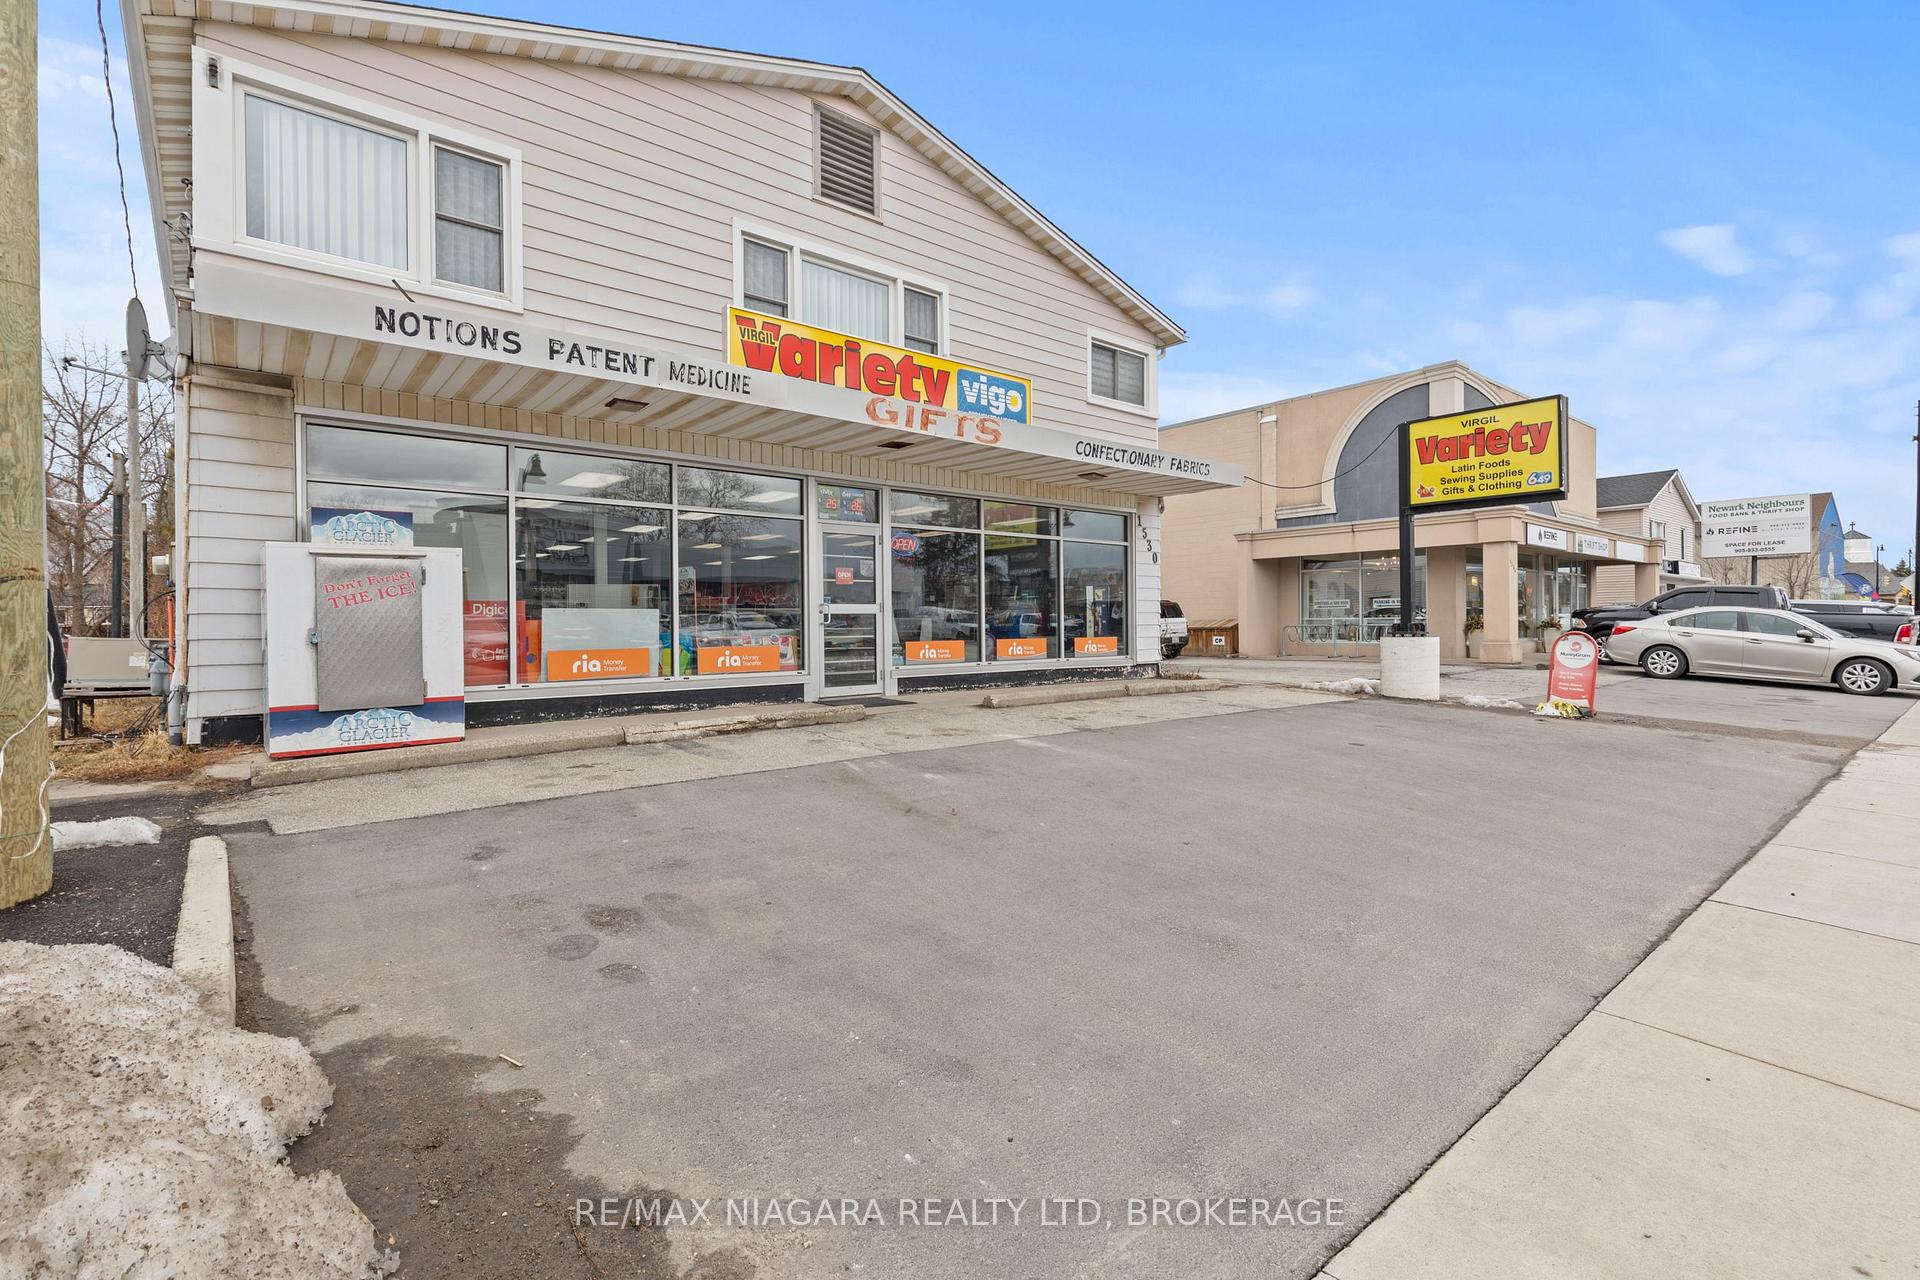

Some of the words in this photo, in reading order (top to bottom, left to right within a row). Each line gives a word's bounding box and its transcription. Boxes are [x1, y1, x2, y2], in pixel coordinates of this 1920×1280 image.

[739, 325, 776, 346] VIRGIL
[375, 306, 522, 354] NOTIONS
[549, 338, 655, 377] PATENT
[669, 360, 751, 395] MEDICINE
[735, 315, 950, 407] Variety
[961, 374, 1023, 416] vigo
[865, 397, 1003, 445] GIFTS
[1461, 415, 1500, 428] VIRGIL
[1415, 421, 1552, 465] Variety
[1075, 440, 1165, 469] CONFECTONARY
[1170, 457, 1210, 476] FABRICS
[1451, 464, 1475, 473] Latin
[1478, 458, 1511, 470] Foods
[1440, 473, 1476, 485] Sewing
[1478, 468, 1524, 483] Supplies
[1442, 484, 1465, 496] Gifts
[1467, 483, 1475, 493] &
[1478, 480, 1522, 492] Clothing
[1708, 503, 1745, 513] Newark
[1747, 499, 1805, 511] Neighbours
[332, 517, 396, 534] ARCTIC
[1718, 525, 1758, 535] REFINE
[333, 530, 395, 544] GLACIER
[890, 538, 917, 551] OPEN
[1137, 515, 1158, 564] 1530
[323, 577, 364, 594] Don't
[366, 569, 412, 587] Forget
[328, 590, 373, 609] THE
[378, 580, 418, 601] ICE!
[920, 645, 937, 659] ria
[1008, 642, 1023, 656] ria
[1084, 639, 1098, 653] ria
[572, 654, 601, 673] ria
[603, 659, 624, 667] Money
[717, 650, 741, 668] ria
[338, 711, 412, 732] ARCTIC
[339, 727, 411, 742] GLACIER
